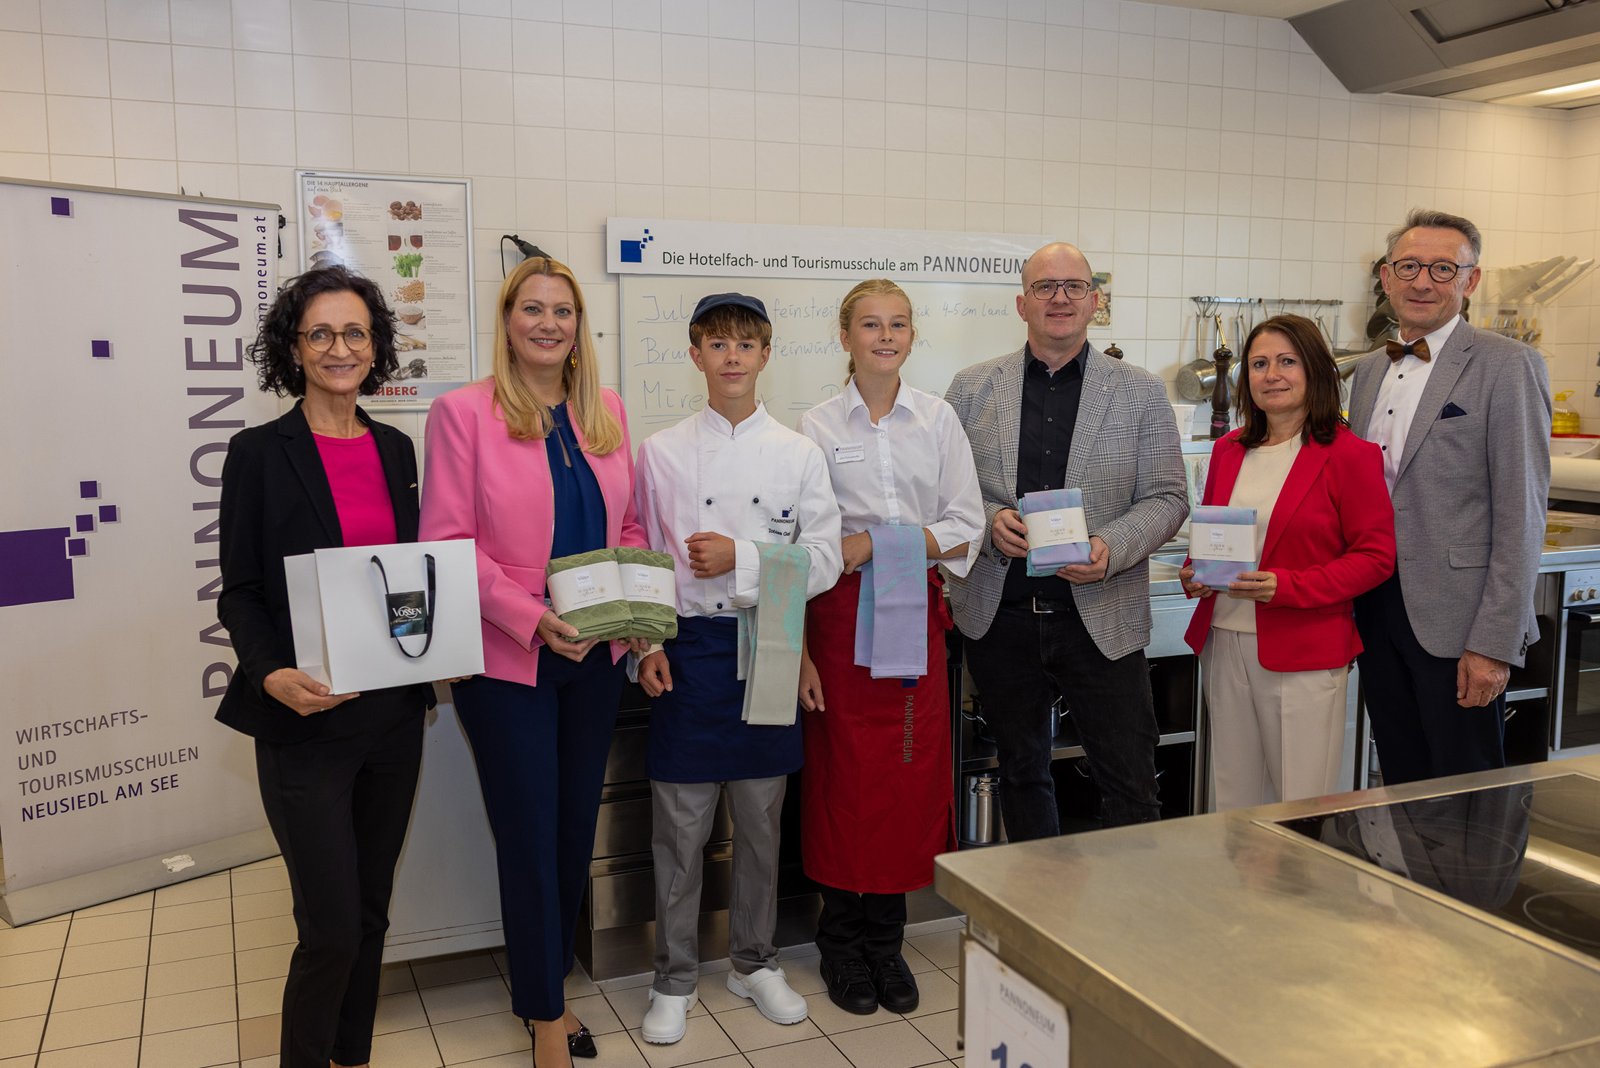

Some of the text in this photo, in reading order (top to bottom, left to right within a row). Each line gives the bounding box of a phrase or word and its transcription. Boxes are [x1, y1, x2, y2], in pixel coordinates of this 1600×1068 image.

[662, 251, 1027, 274] Die Hotelfach- und Tourismusschule am PANNONEUM
[392, 606, 422, 619] VOSSEN
[15, 709, 149, 745] WIRTSCHAFTS-
[903, 695, 915, 763] PANNONEUM
[18, 750, 57, 770] UND
[18, 746, 200, 796] TOURISMUSSCHULEN
[21, 774, 180, 822] NEUSIEDL AM SEE
